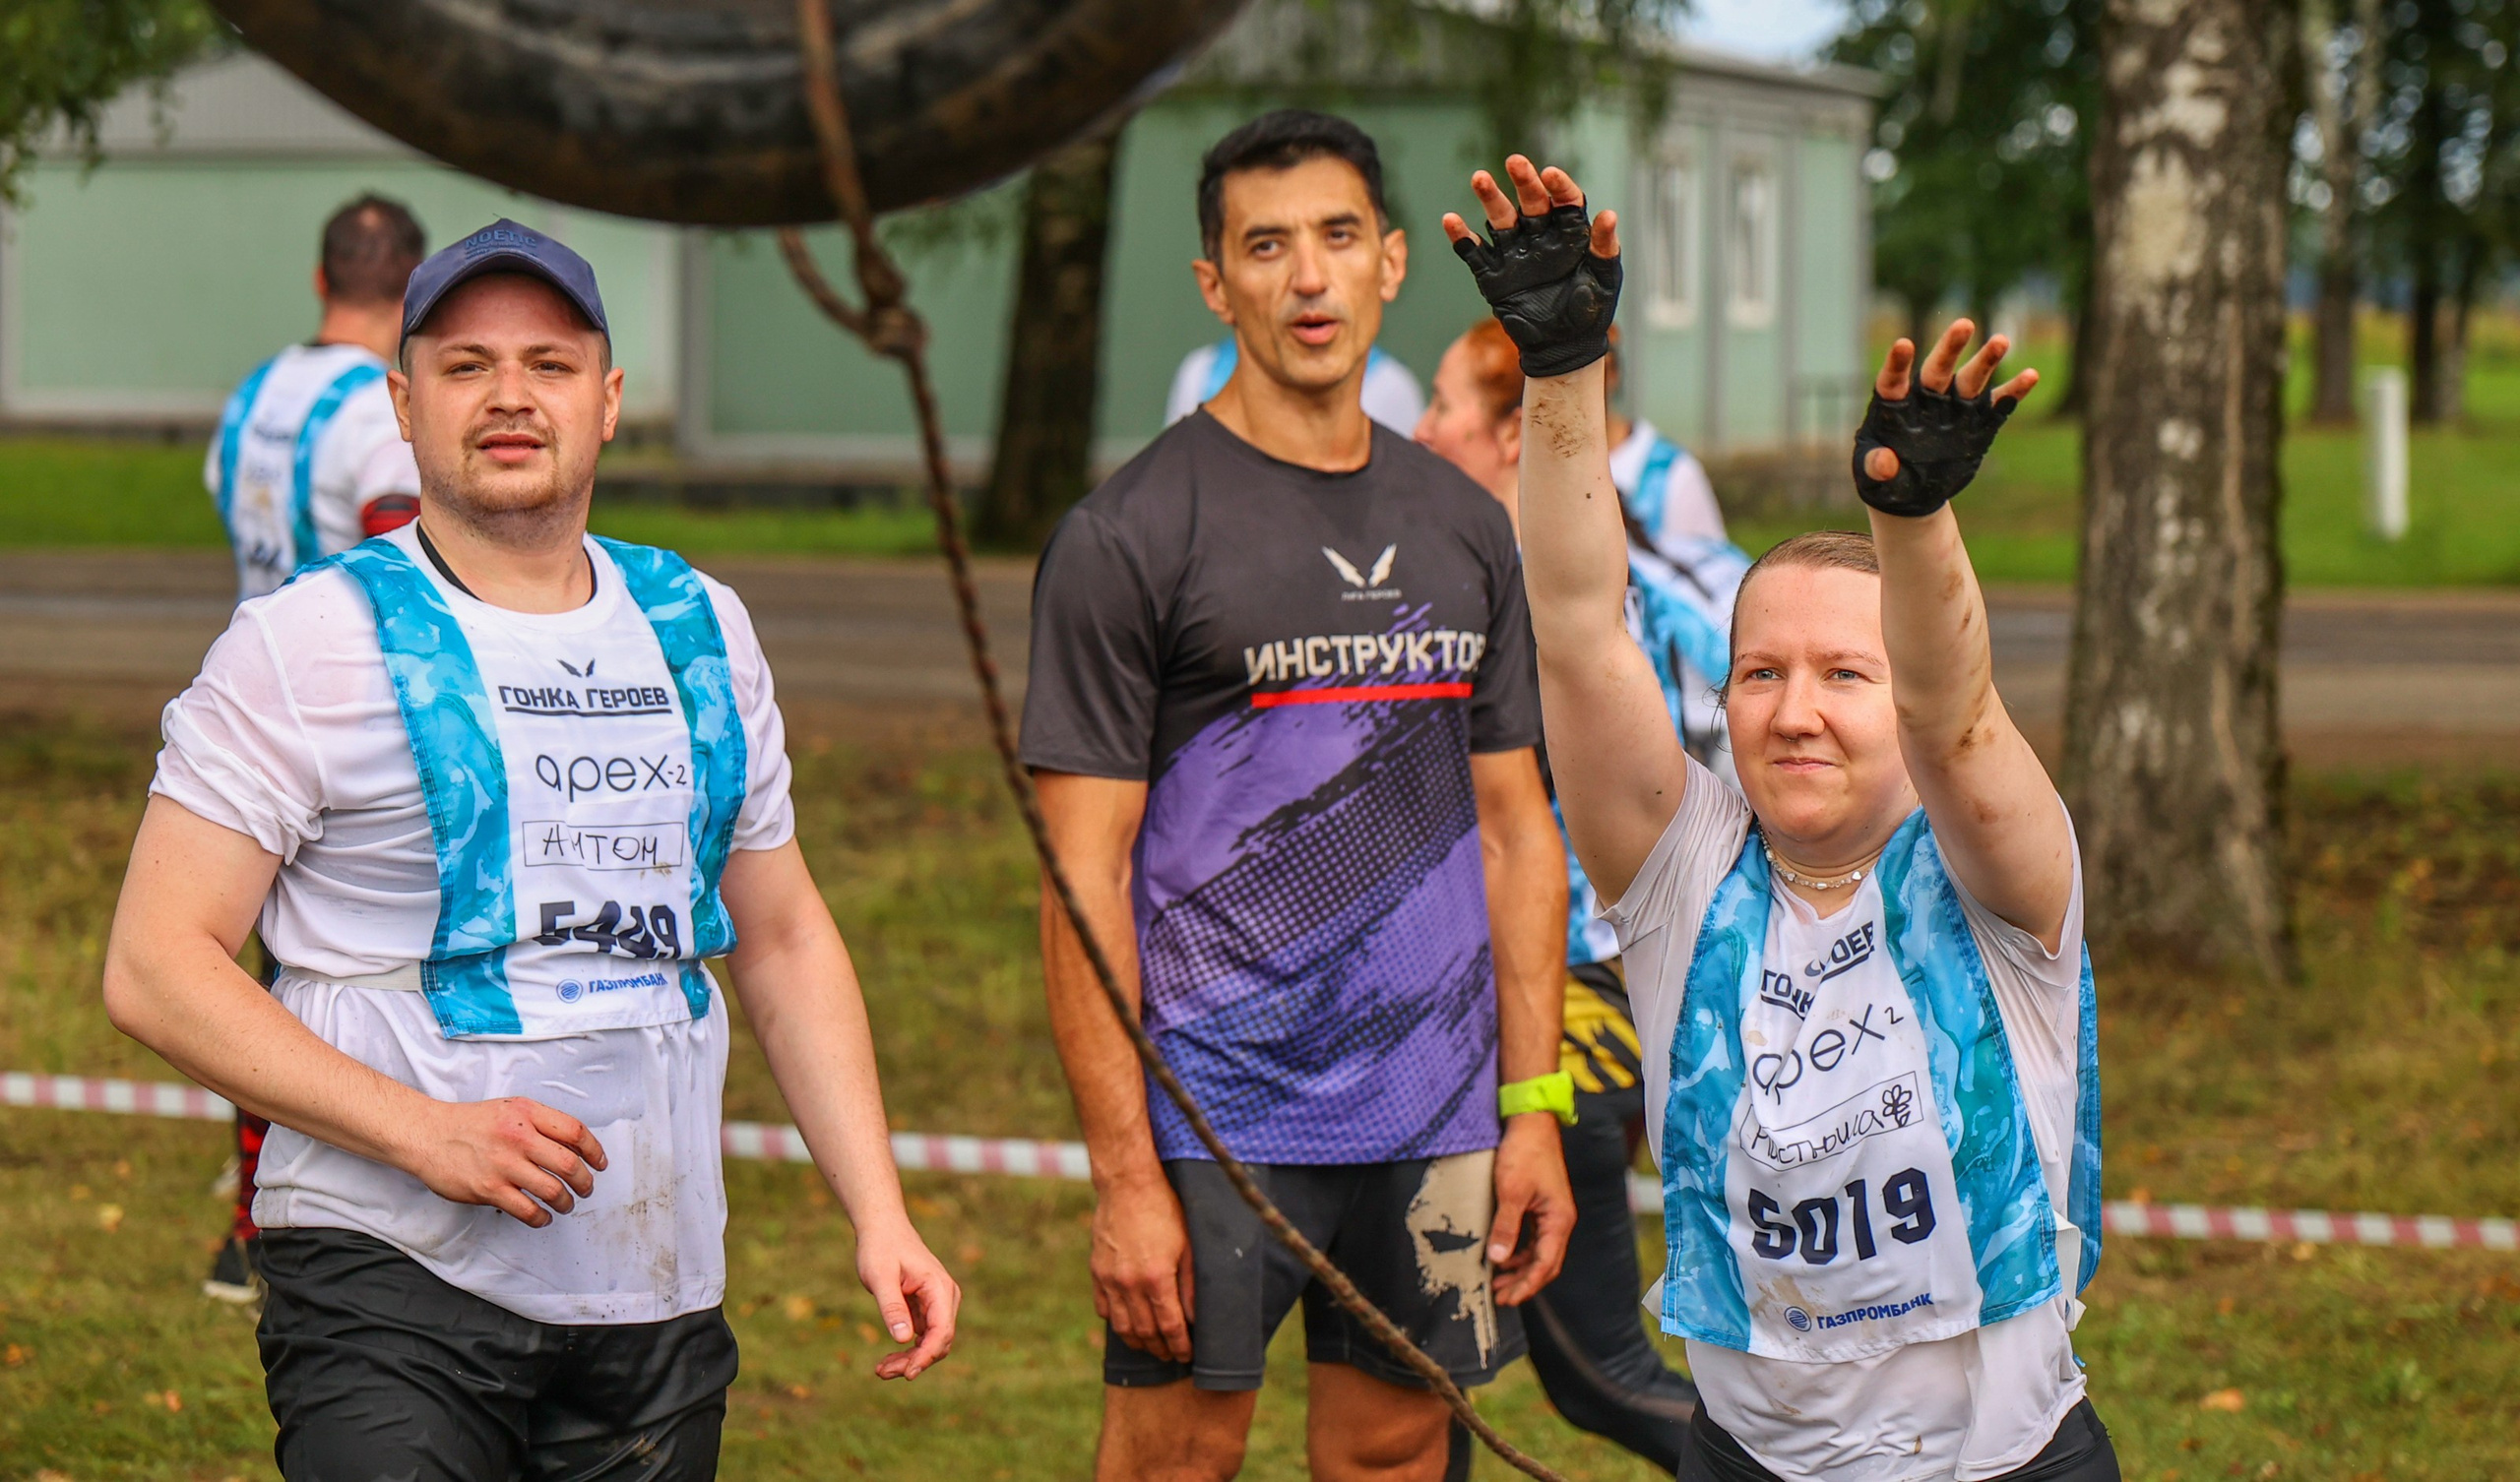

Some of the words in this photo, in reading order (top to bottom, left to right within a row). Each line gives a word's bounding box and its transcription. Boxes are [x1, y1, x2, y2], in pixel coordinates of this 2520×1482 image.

[465, 228, 537, 249] NOETIC
[498, 685, 580, 709] ГОНКА
[586, 687, 669, 709] ГЕРОЕВ
[533, 900, 681, 959] 5449
[1748, 1167, 1936, 1266] 5019
[1816, 1292, 1934, 1329] ГАЗПРОМБАНК
